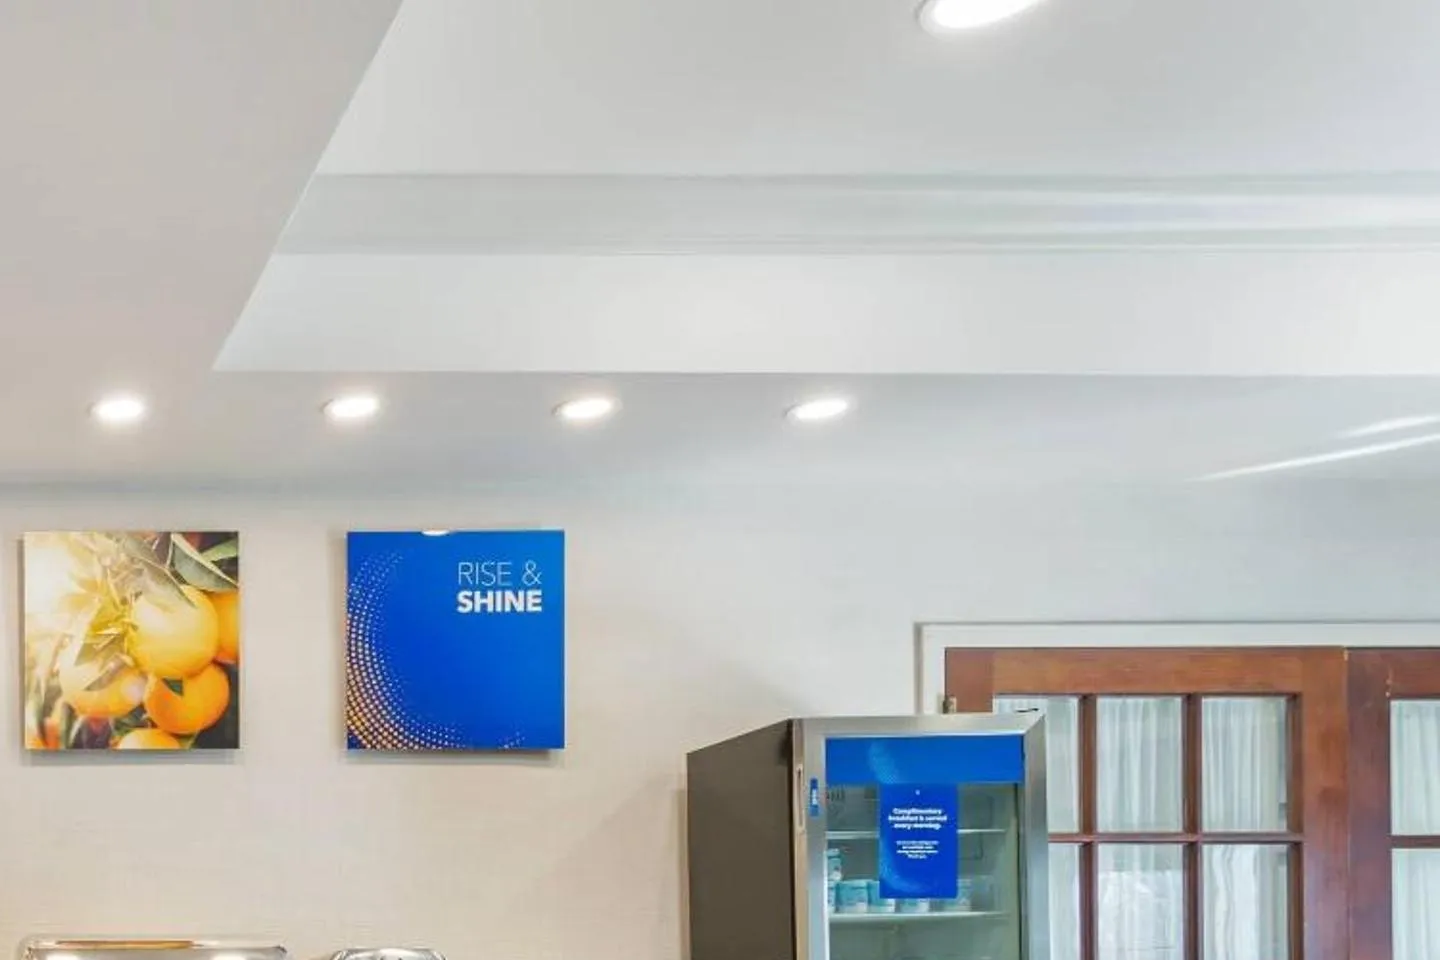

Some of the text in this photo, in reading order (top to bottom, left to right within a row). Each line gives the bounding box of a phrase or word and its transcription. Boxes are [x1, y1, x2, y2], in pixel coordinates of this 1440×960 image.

[458, 559, 543, 587] RISE &
[456, 589, 543, 614] SHINE
